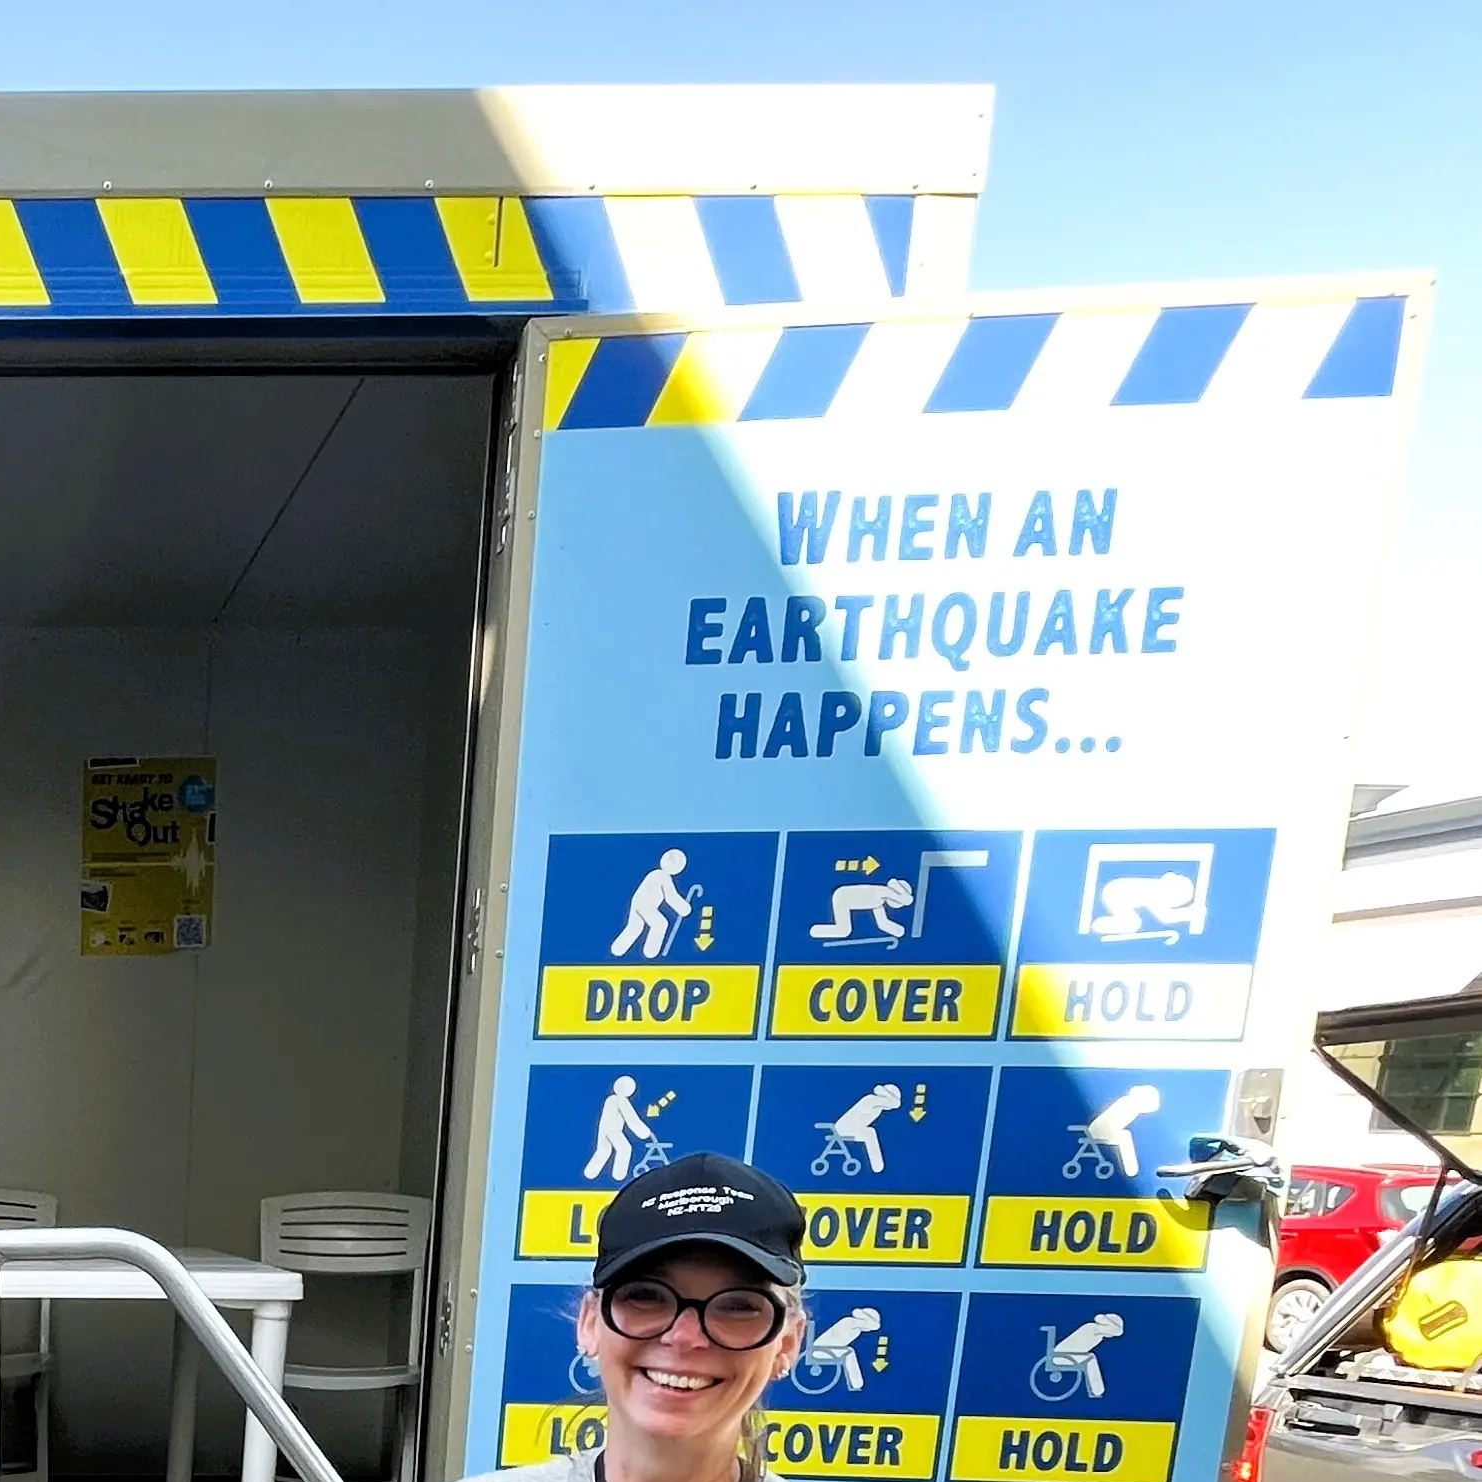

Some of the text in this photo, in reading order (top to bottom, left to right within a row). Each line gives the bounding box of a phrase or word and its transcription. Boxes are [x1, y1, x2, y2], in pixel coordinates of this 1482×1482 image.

[776, 488, 1118, 567] WHEN AN
[684, 586, 1185, 672] EARTHQUAKE
[714, 687, 1123, 760] HAPPENS...
[125, 820, 180, 847] Out
[584, 979, 712, 1023] DROP
[809, 979, 964, 1024] COVER
[1064, 980, 1194, 1023] HOLD
[803, 1206, 932, 1250] OVER
[1030, 1210, 1157, 1253] HOLD
[550, 1417, 604, 1455] LO
[758, 1422, 904, 1466] COVER
[999, 1429, 1123, 1472] HOLD
